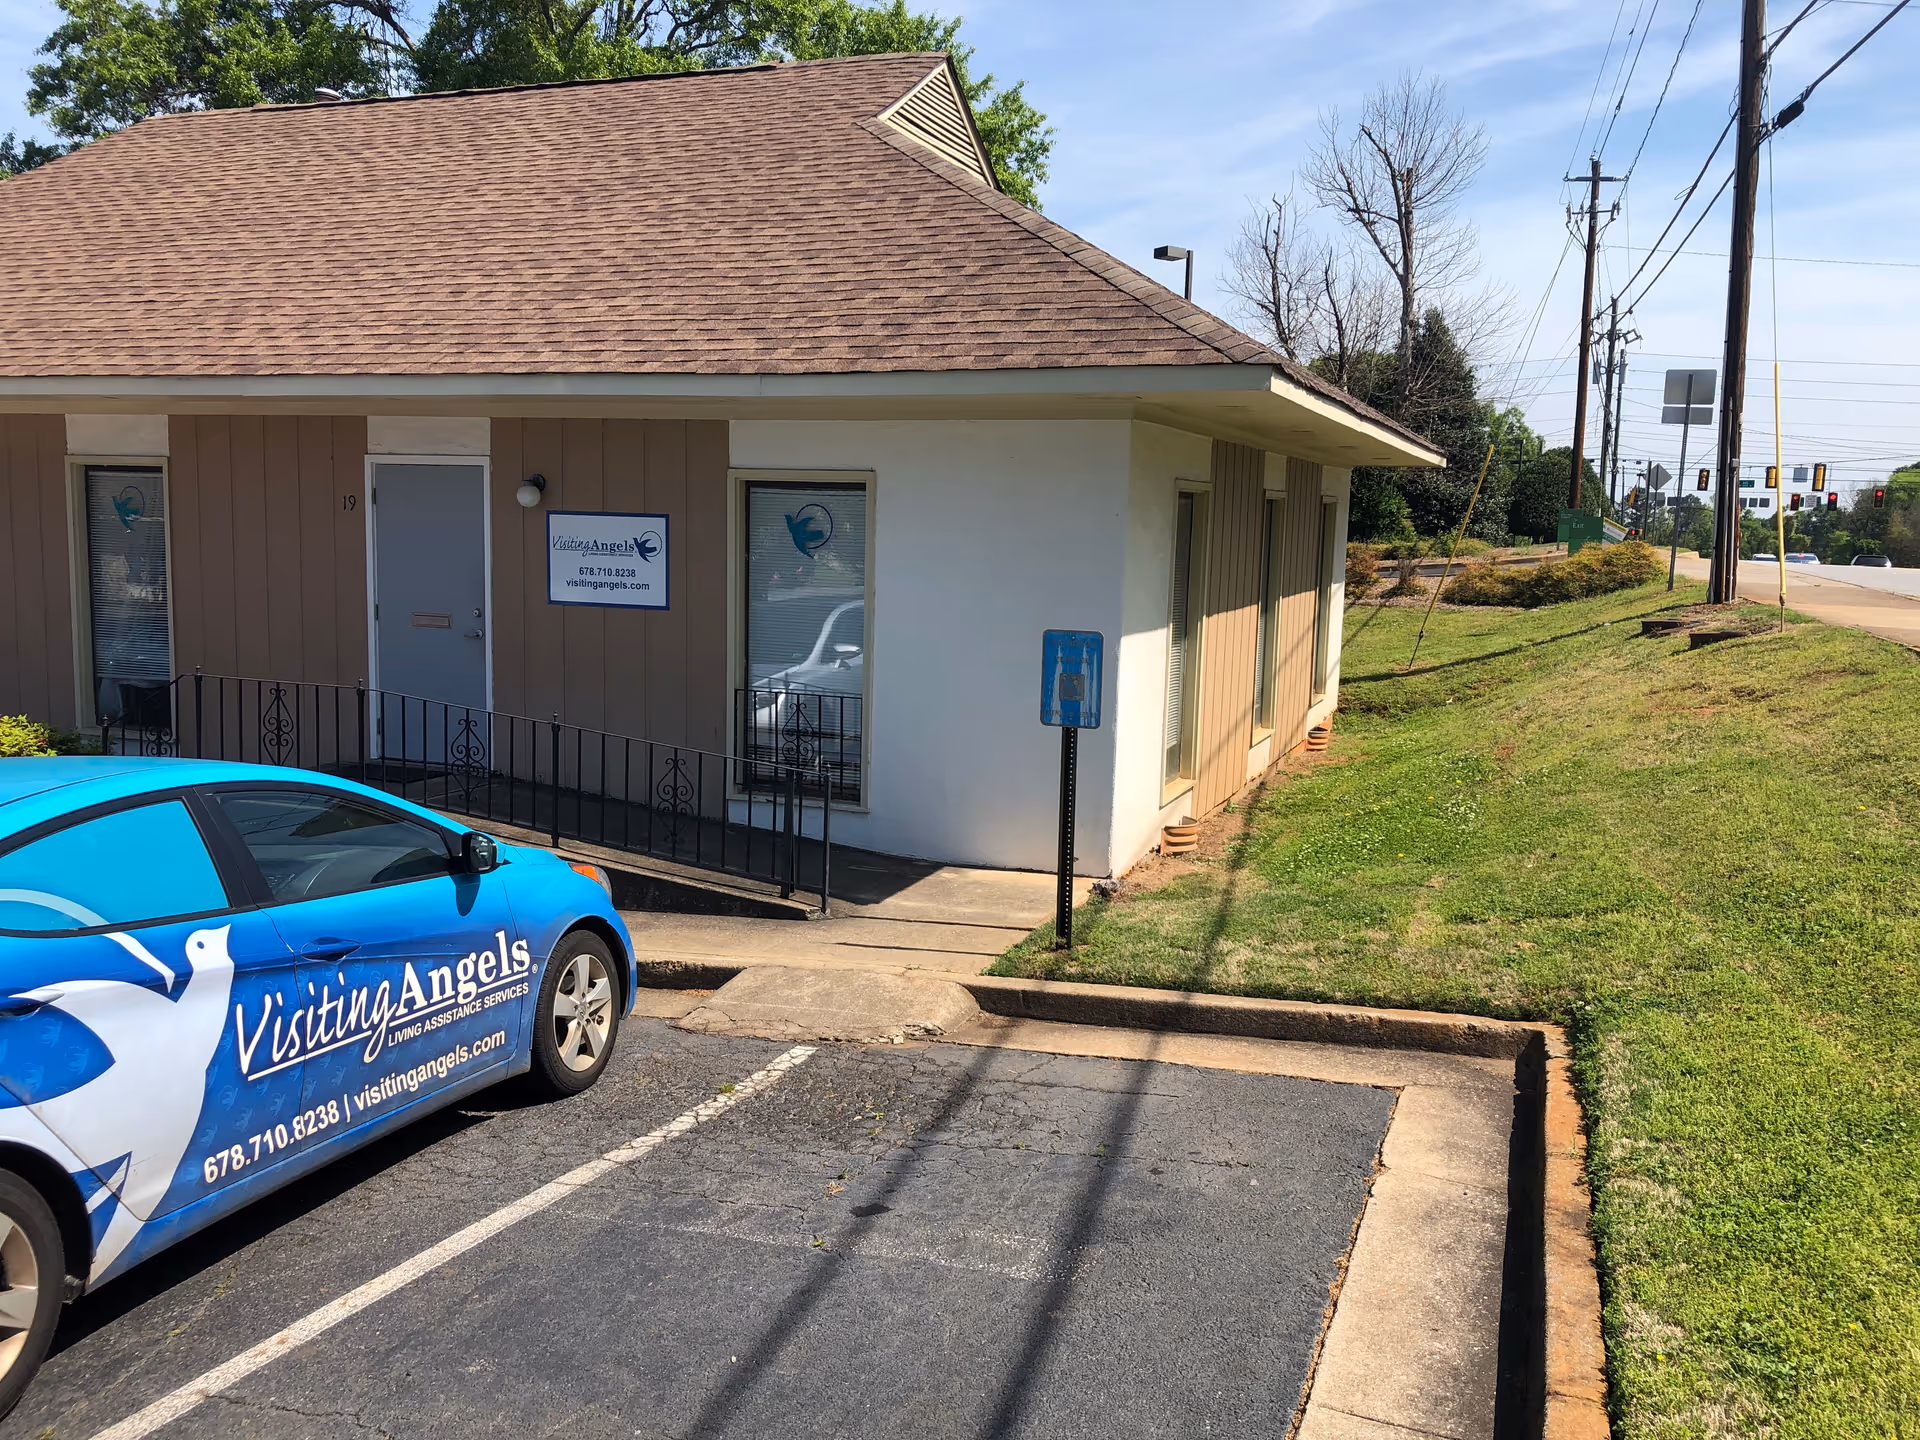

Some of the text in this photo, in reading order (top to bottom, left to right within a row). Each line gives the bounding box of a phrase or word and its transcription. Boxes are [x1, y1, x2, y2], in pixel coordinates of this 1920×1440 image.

[343, 495, 356, 511] 19
[552, 536, 592, 557] Visiting
[579, 566, 636, 578] 678.710.8238
[566, 578, 650, 590] visitingangels.com
[236, 972, 398, 1075] Visiting
[388, 982, 529, 1047] LIVING ASSISTANCE SERVICES
[203, 1099, 340, 1184] 678.710.8238
[354, 1030, 506, 1112] visitingangels.com
